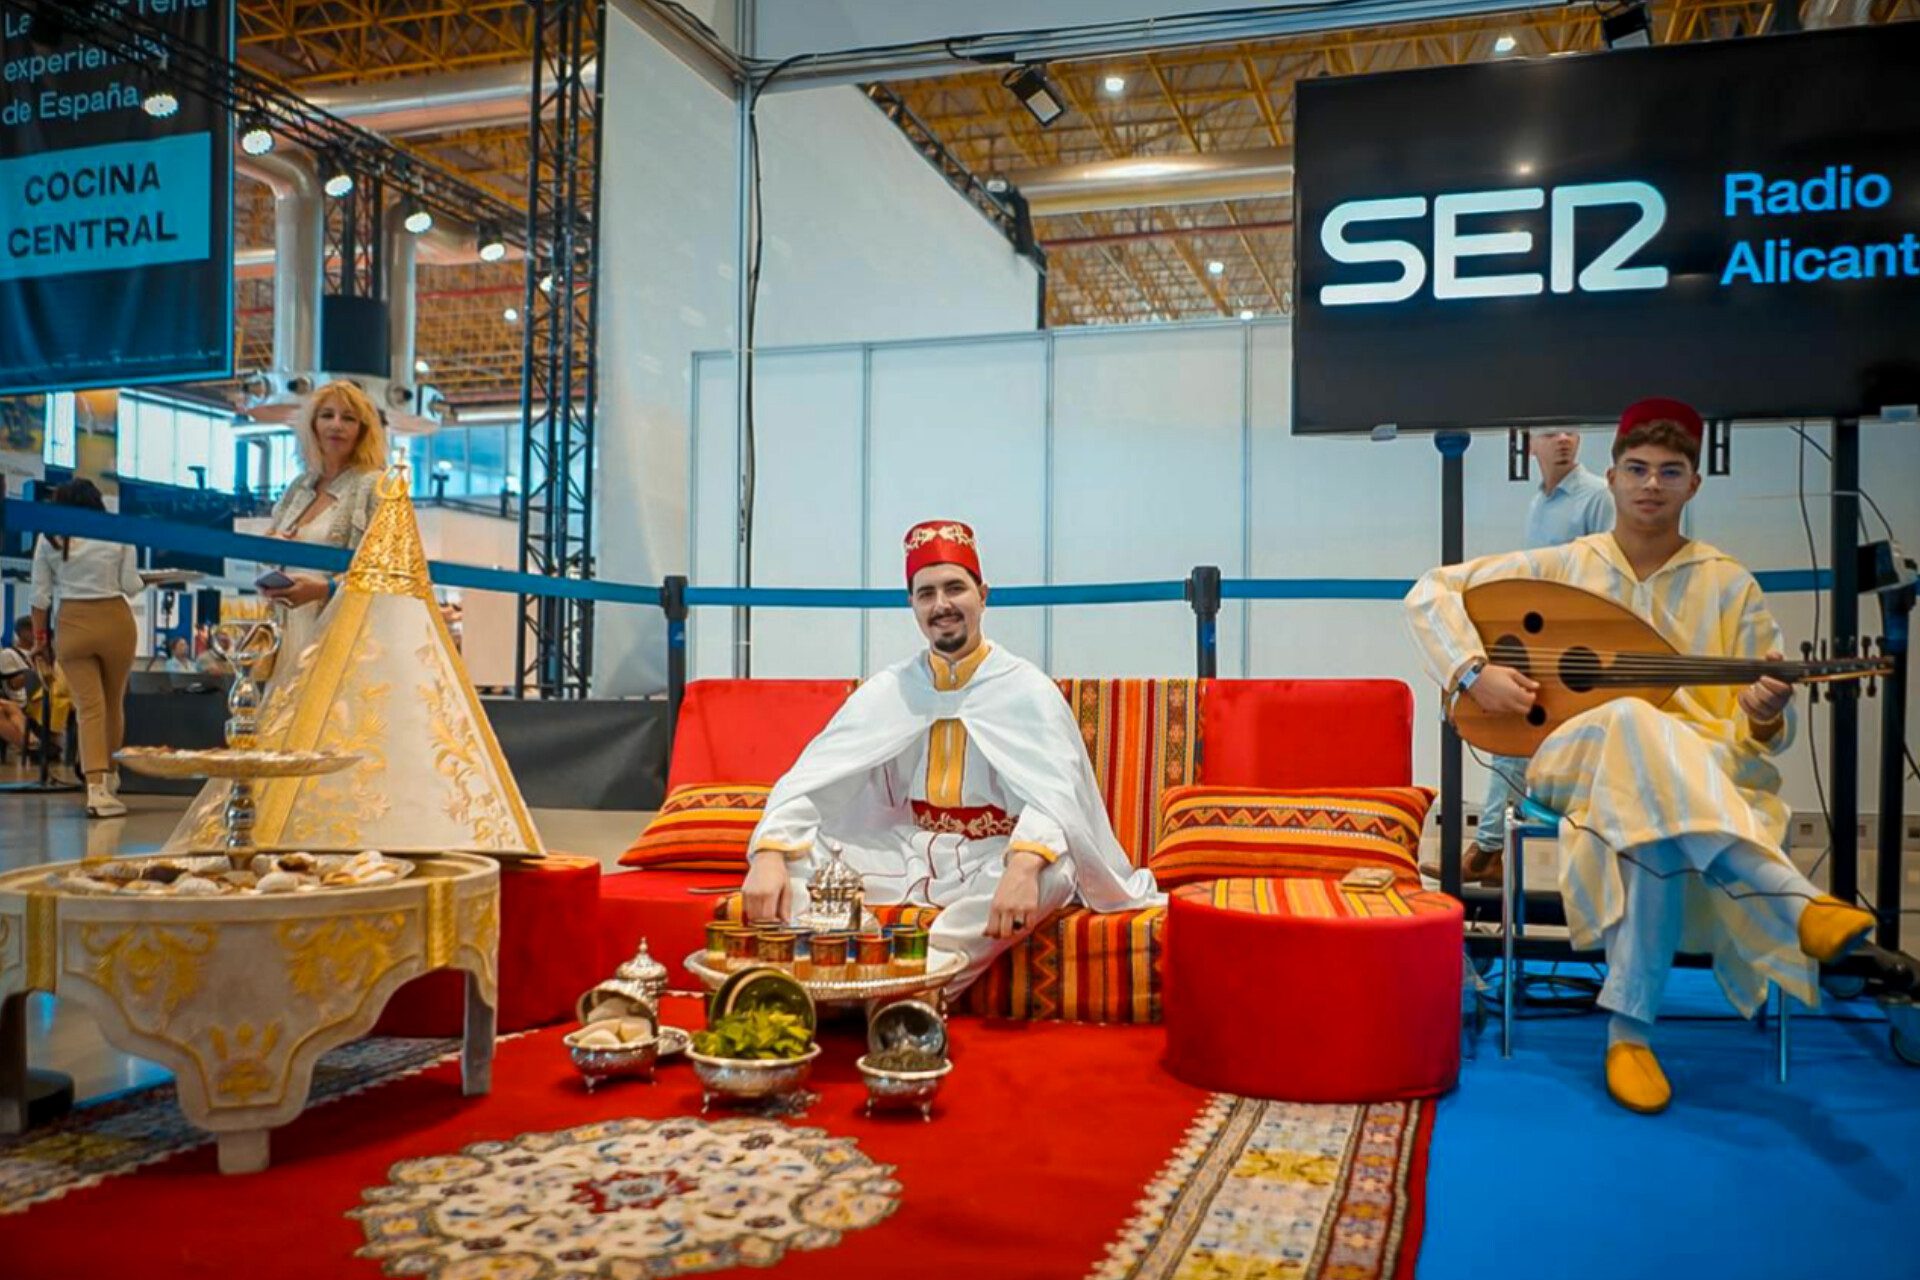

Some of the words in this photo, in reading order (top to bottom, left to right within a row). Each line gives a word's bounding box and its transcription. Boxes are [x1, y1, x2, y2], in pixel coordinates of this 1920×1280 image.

[2, 100, 31, 125] de
[40, 81, 139, 121] España
[24, 161, 161, 206] COCINA
[1724, 165, 1892, 217] Radio
[8, 211, 178, 258] CENTRAL
